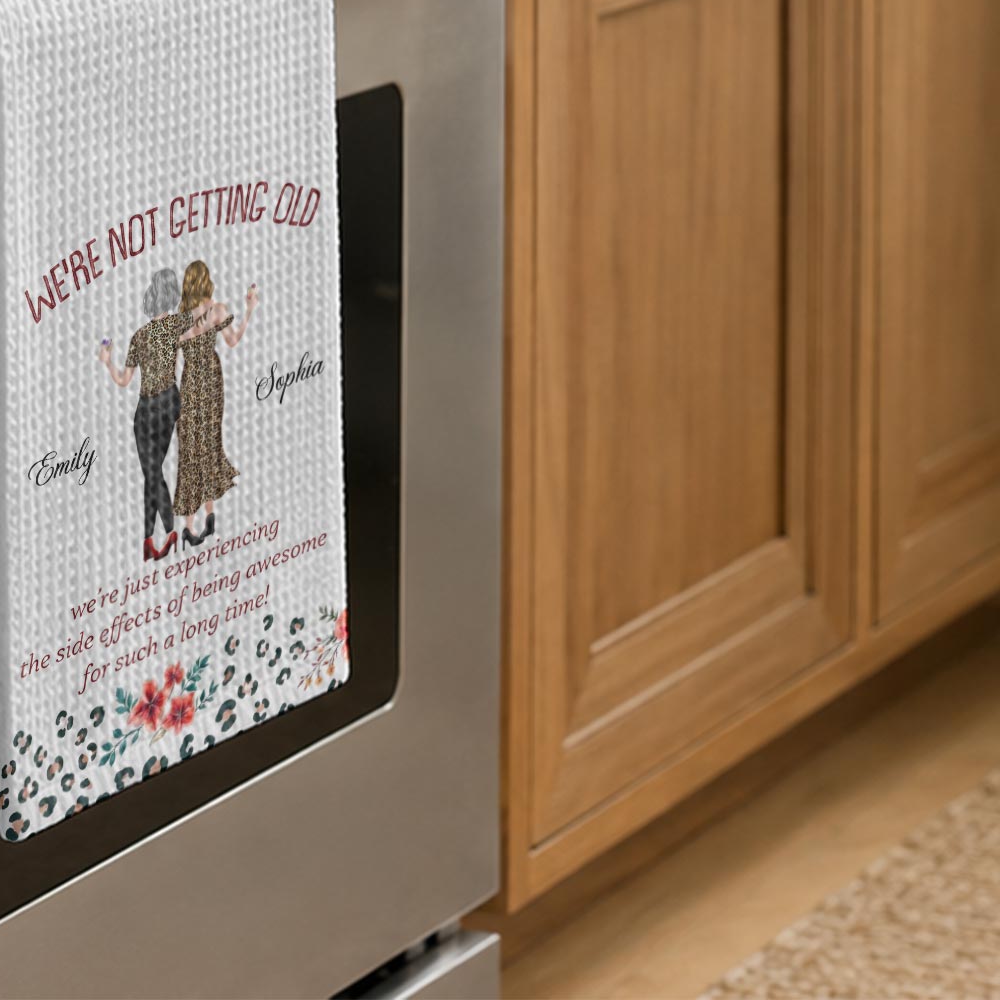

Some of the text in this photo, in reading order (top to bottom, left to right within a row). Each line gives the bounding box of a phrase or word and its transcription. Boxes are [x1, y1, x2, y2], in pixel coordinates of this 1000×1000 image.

[25, 181, 320, 323] WE'RE NOT GETTING OLD
[255, 352, 324, 404] Sophia
[28, 437, 97, 487] Emily
[20, 532, 327, 678] the side effects of being awesome
[71, 519, 279, 620] we're just experiencing
[78, 584, 270, 695] for such a long time!
